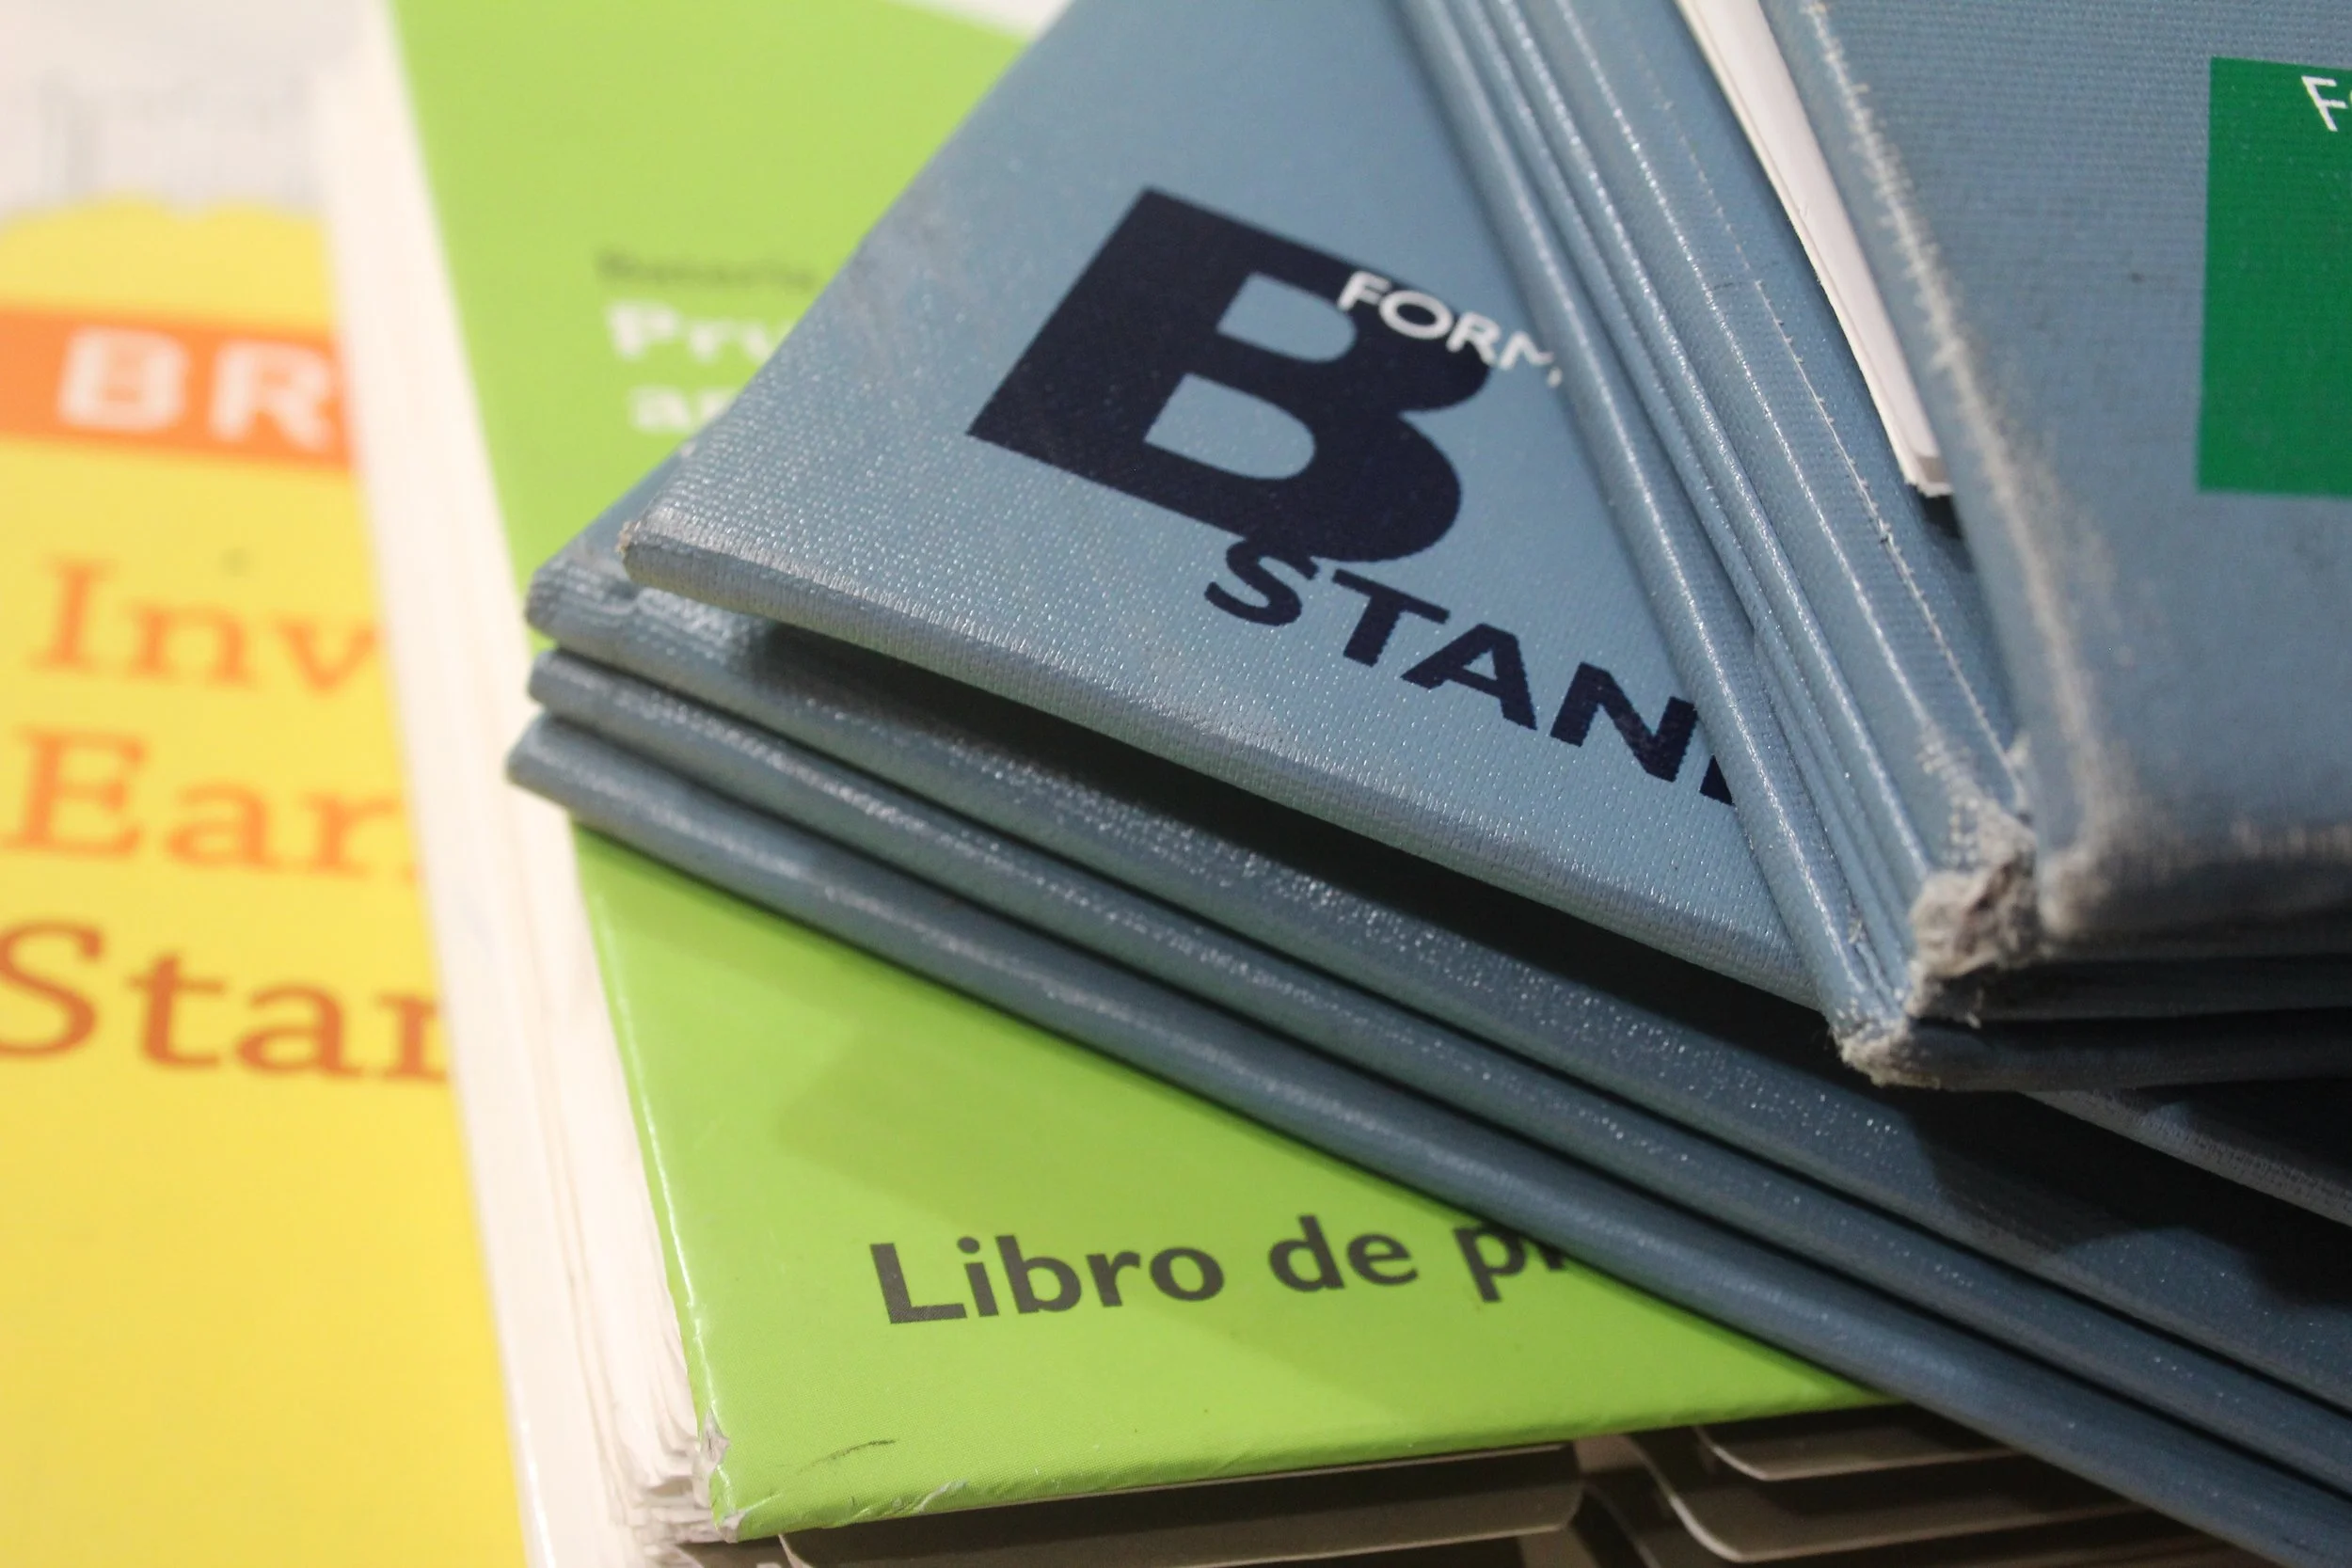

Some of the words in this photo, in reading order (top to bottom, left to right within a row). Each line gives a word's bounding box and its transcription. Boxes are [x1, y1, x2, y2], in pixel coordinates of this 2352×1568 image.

[2301, 75, 2352, 132] F
[1204, 537, 1736, 807] STAN
[869, 1234, 1225, 1324] Libro
[1268, 1213, 1418, 1292] de
